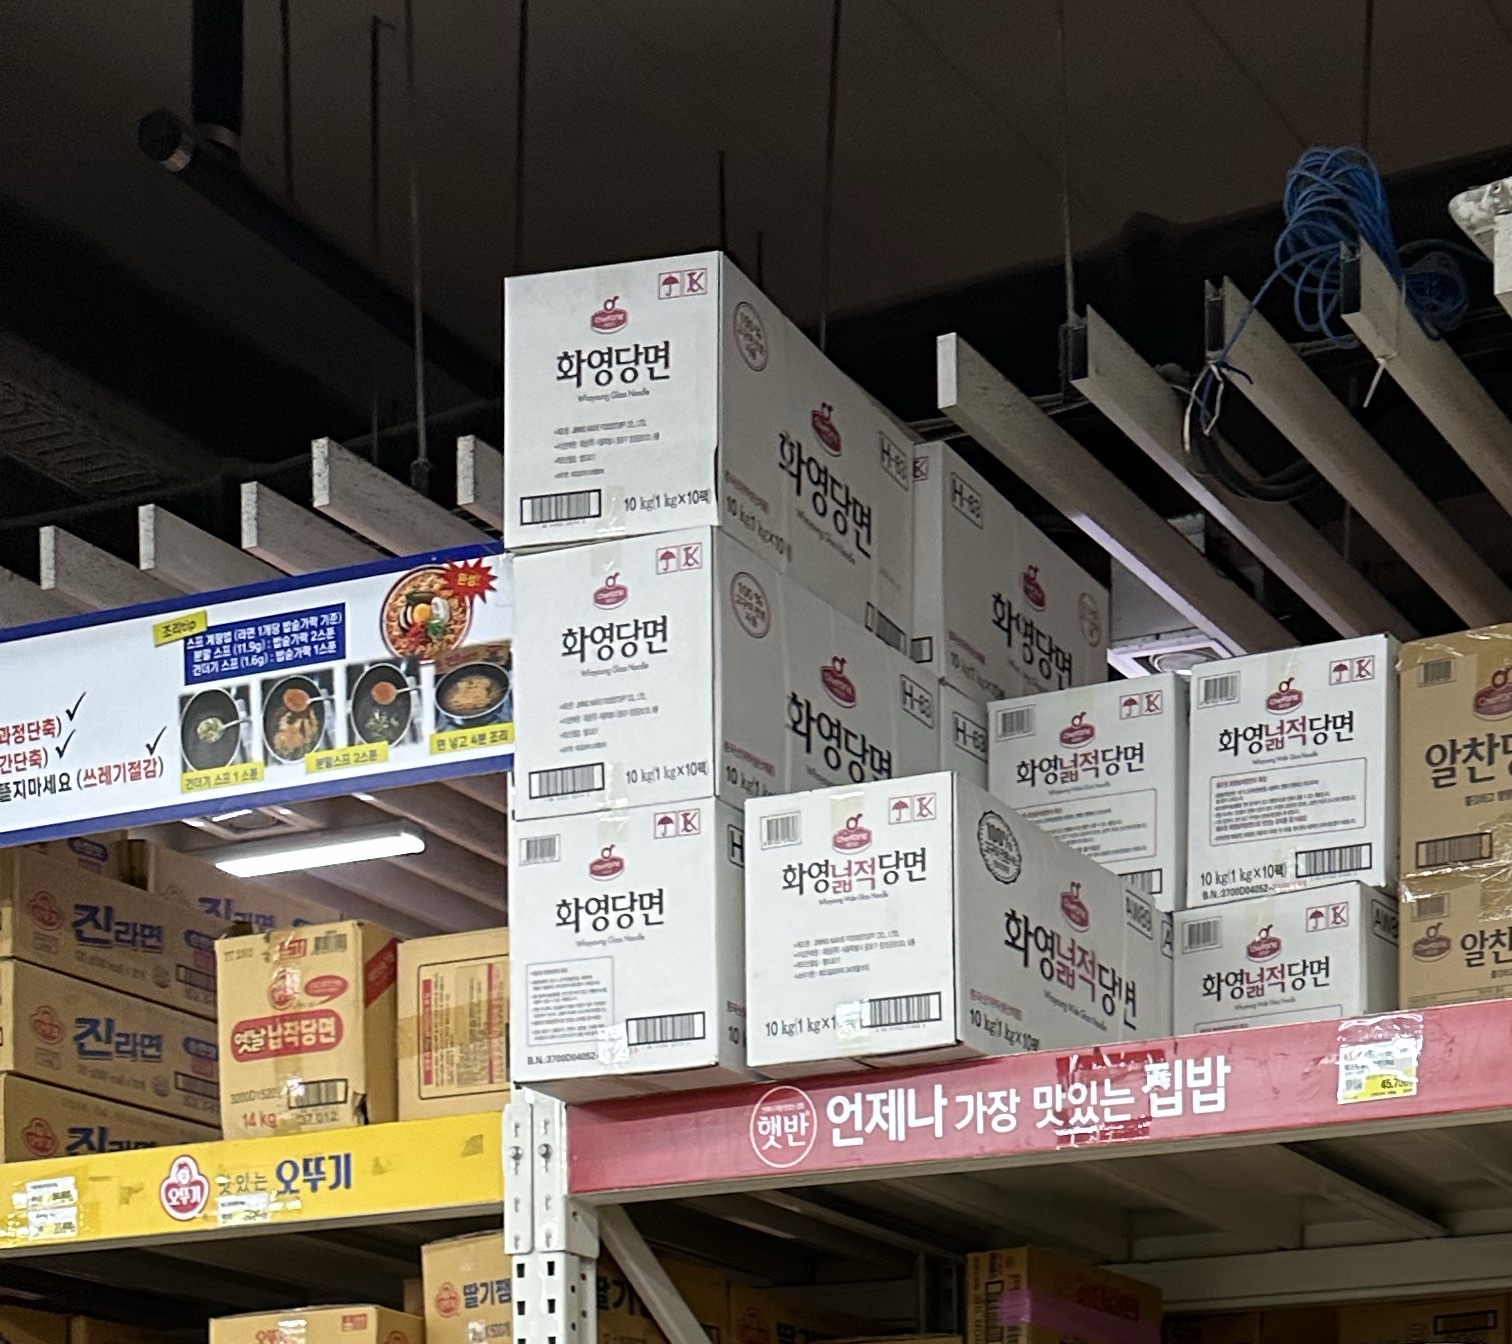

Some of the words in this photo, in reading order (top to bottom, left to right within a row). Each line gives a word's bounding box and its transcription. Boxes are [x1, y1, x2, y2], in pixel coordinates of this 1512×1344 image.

[557, 341, 670, 388] 화영당면
[778, 431, 873, 559] 화영당면
[561, 615, 669, 664] 화영당면
[1218, 711, 1353, 757] 화영넓적당면
[77, 756, 164, 790] (쓰레기절감)
[1016, 743, 1145, 788] 화영넓적당면
[782, 848, 926, 895] 화영넓적당면
[71, 903, 163, 947] 진라면
[555, 888, 665, 933] 화영당면
[1202, 956, 1331, 1001] 화영넓적당면
[72, 1015, 163, 1059] 진라면
[757, 1112, 810, 1150] 햇반
[826, 1083, 946, 1146] 언제나
[953, 1091, 1021, 1133] 가장
[1032, 1080, 1135, 1130] 맛있는
[275, 1153, 353, 1194] 오뚜기
[165, 1188, 203, 1205] 오뚜기
